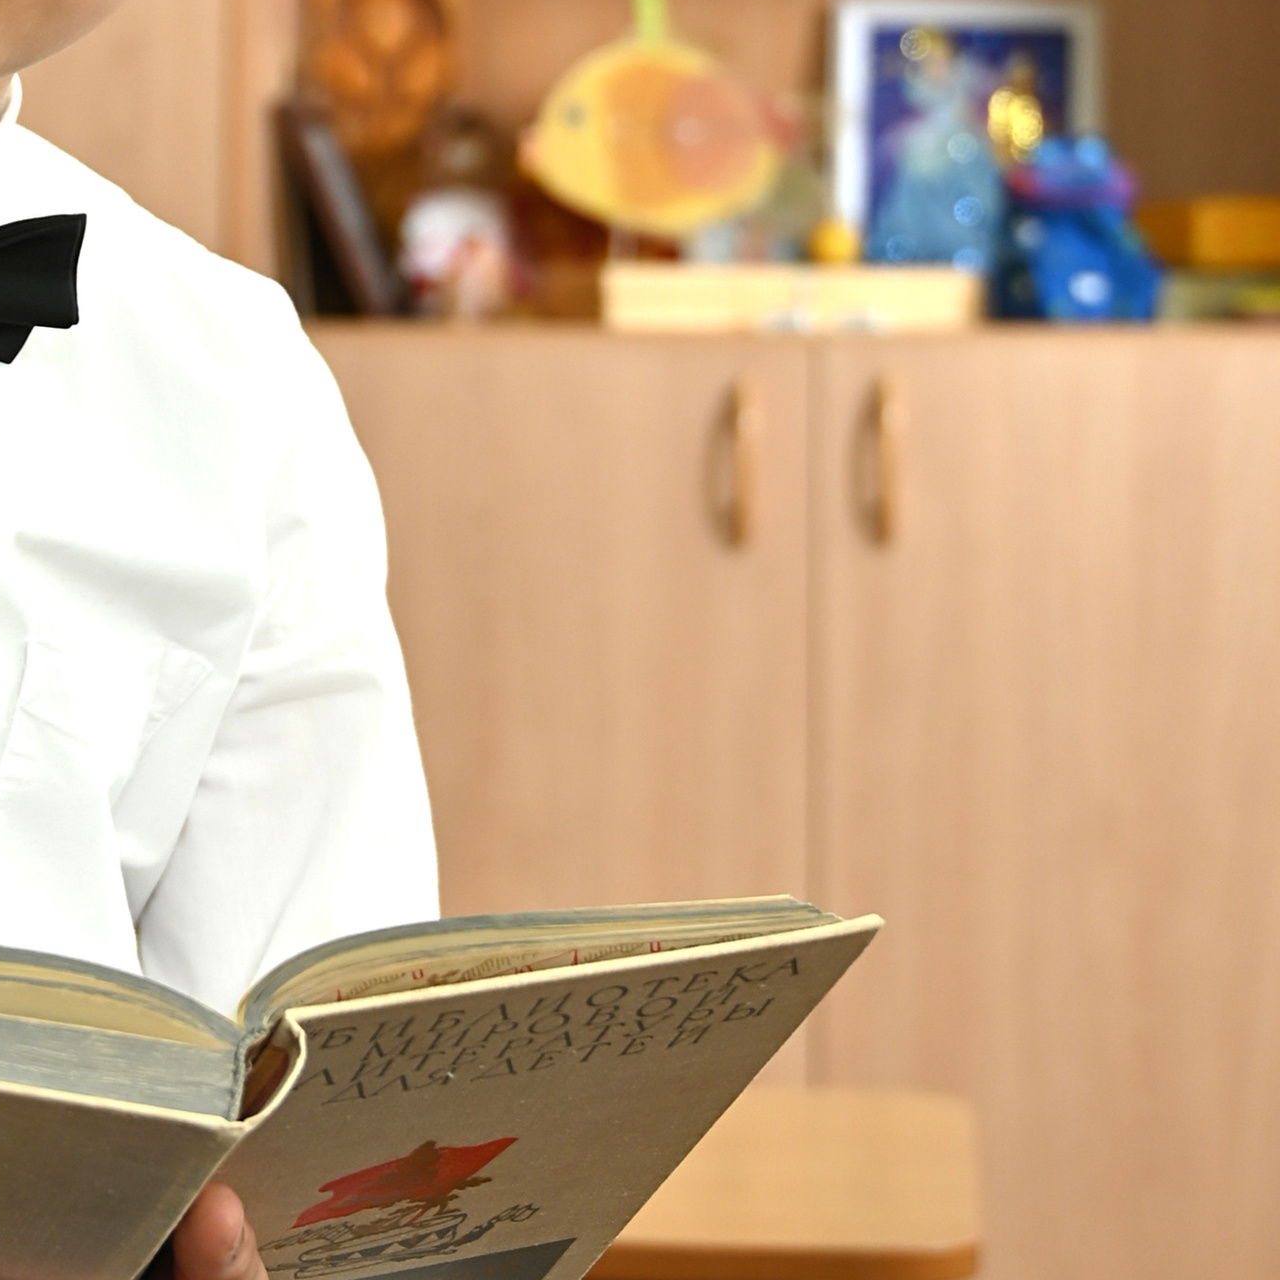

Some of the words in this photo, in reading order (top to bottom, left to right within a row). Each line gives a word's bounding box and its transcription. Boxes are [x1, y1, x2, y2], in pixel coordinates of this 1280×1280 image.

[293, 997, 775, 1091] ЛИТЕРАТУРЫ
[361, 983, 737, 1061] МИРОВОЙ
[321, 1067, 457, 1106] ДЛЯ
[470, 1023, 711, 1083] ДЕТЕЙ
